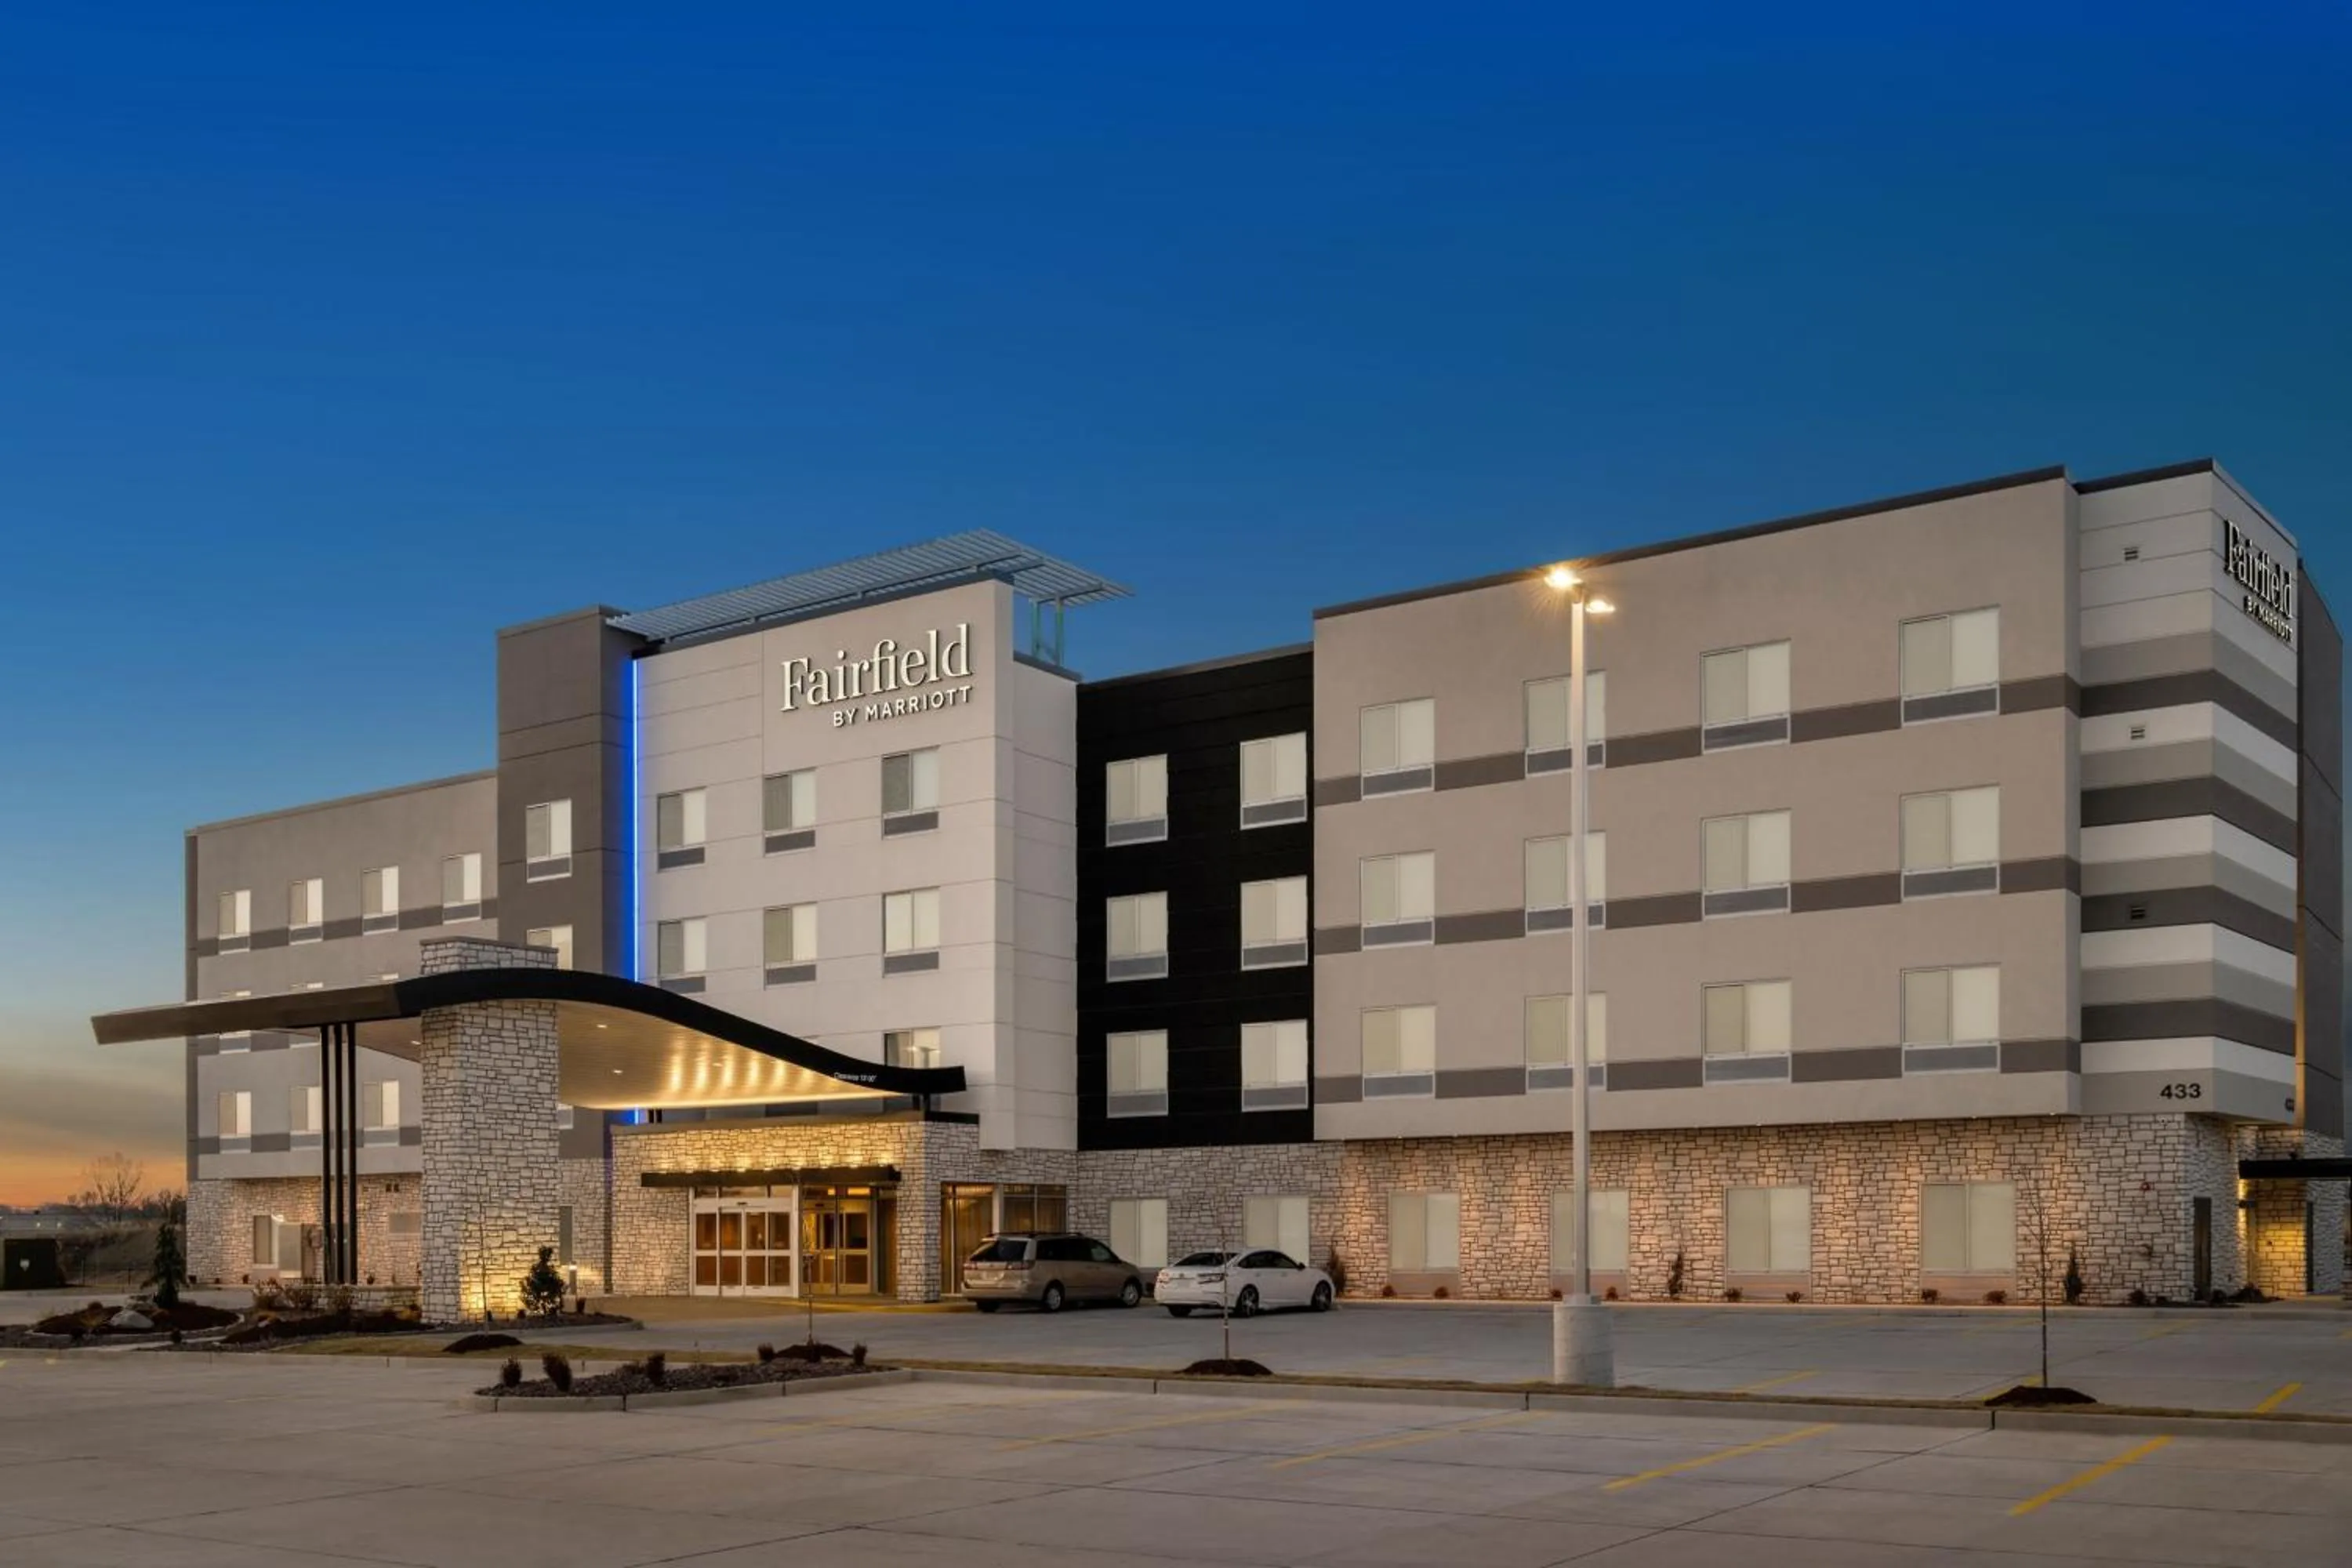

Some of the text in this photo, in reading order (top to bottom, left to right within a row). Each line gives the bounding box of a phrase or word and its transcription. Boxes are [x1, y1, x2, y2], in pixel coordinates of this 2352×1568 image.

[2224, 519, 2293, 619] Fairfield
[780, 622, 974, 712] Fairfield
[833, 684, 973, 728] BY MARRIOTT
[2160, 1083, 2201, 1099] 433
